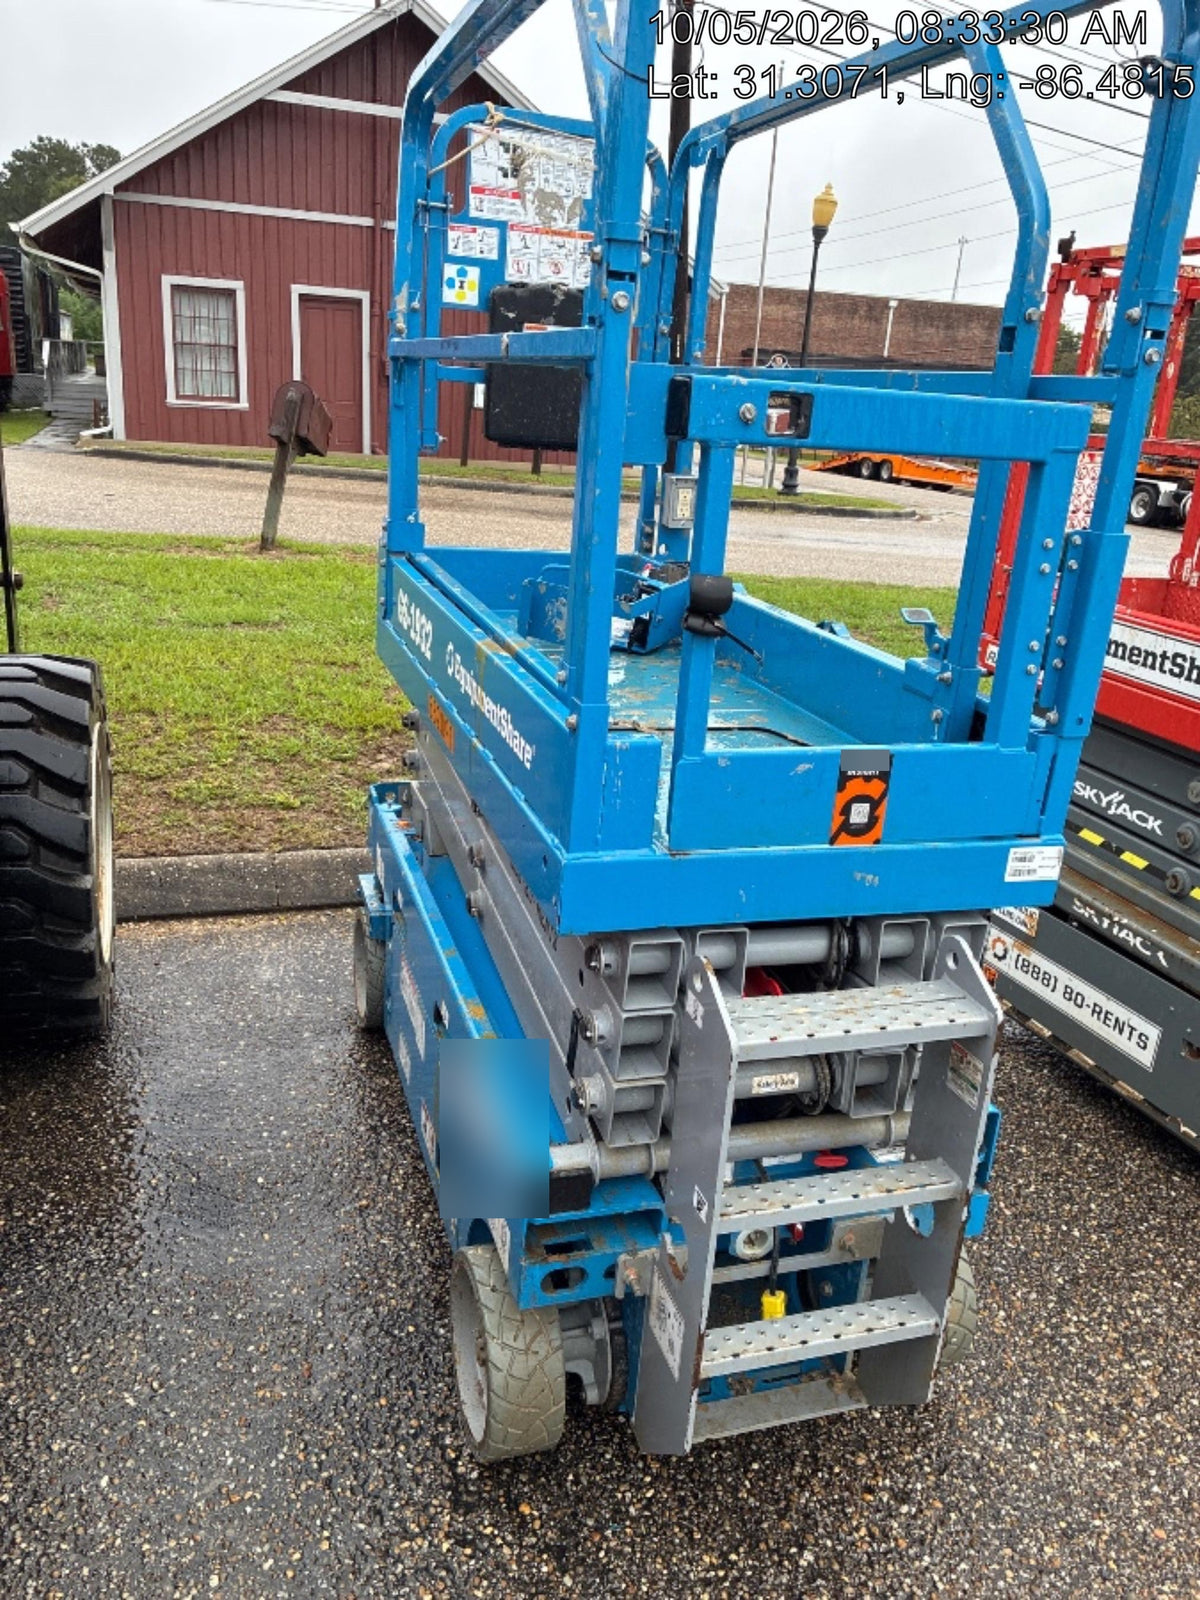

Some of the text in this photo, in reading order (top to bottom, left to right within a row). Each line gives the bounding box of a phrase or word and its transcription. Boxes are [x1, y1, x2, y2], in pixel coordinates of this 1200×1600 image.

[1073, 780, 1163, 836] SKYJACK
[1014, 953, 1150, 1051] (888) 80-RENTS
